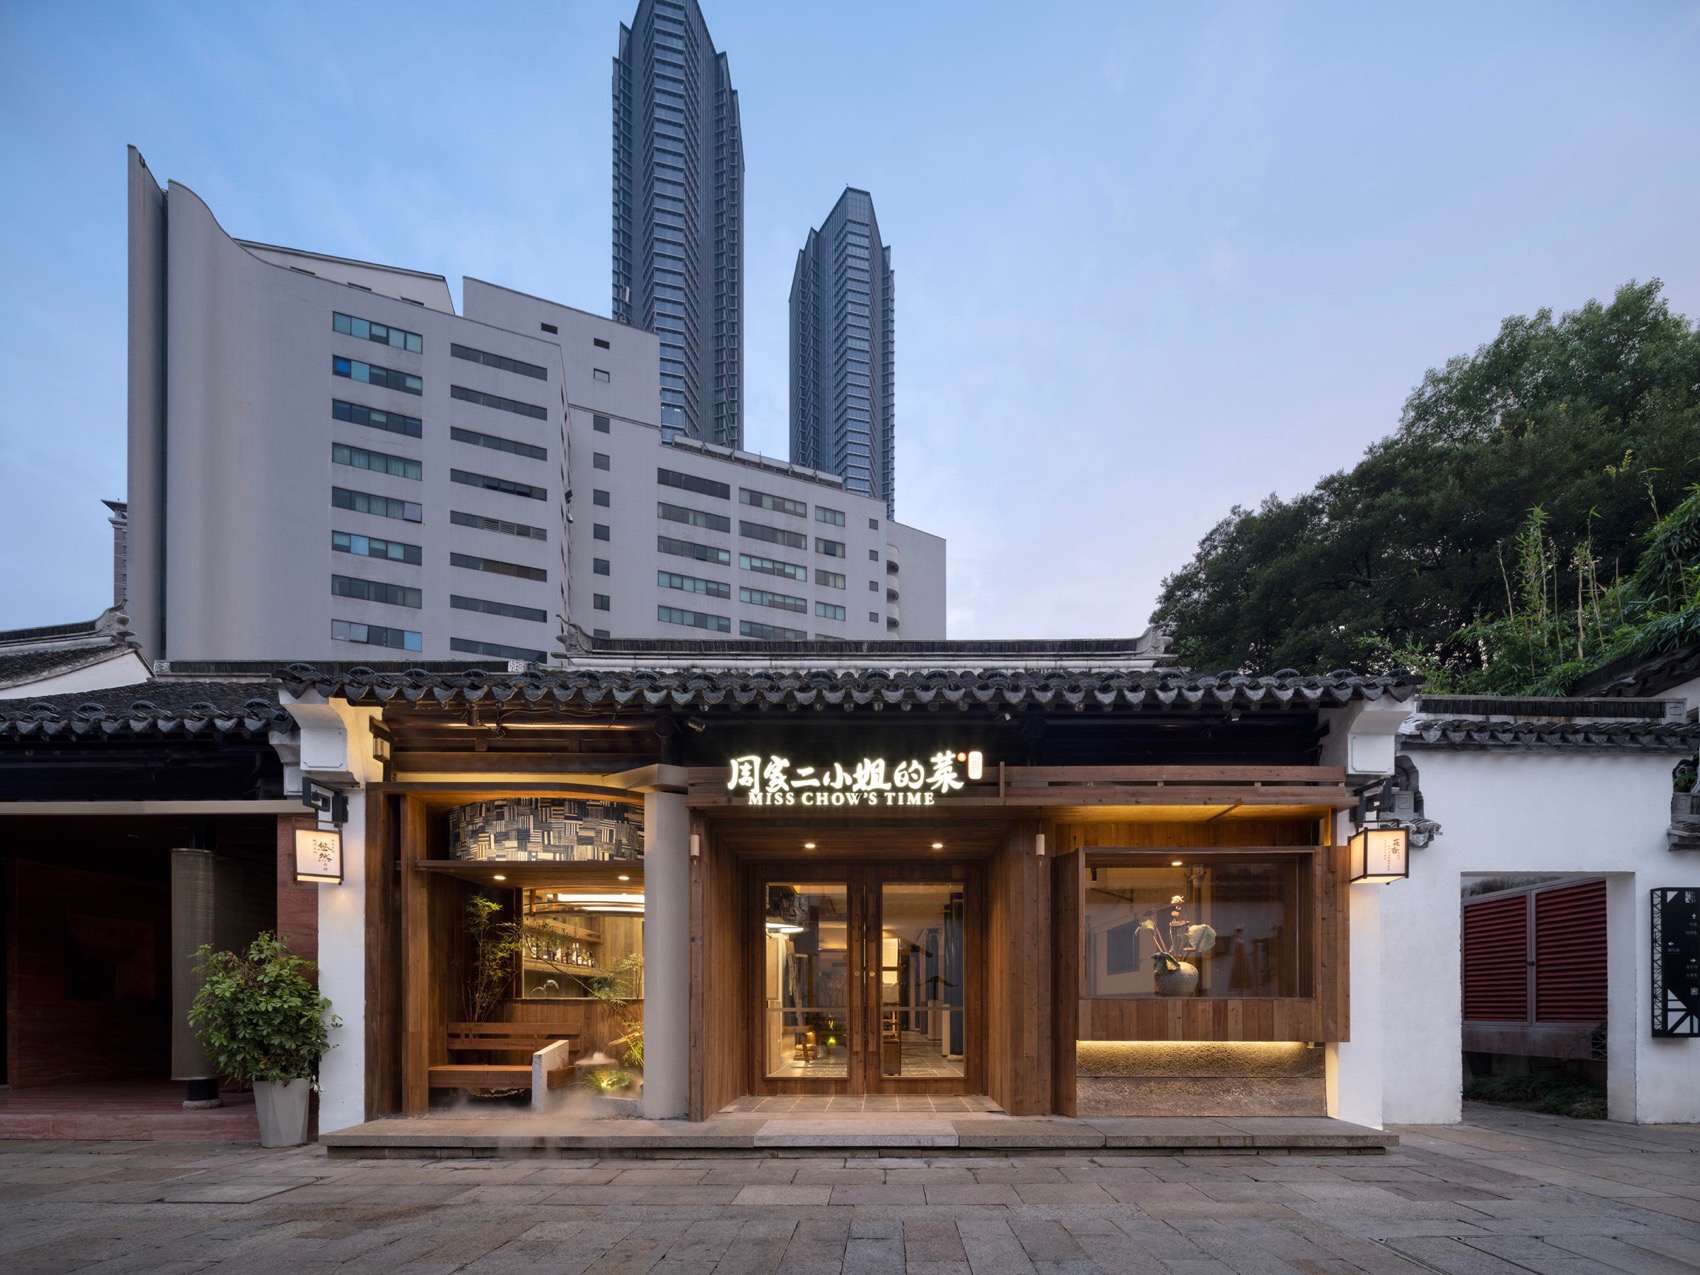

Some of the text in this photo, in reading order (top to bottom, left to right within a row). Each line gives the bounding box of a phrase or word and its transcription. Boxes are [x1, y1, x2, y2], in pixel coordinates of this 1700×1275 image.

[727, 750, 965, 793] 周家二小姐的菜
[748, 792, 795, 806] MISS
[884, 792, 935, 806] TIME
